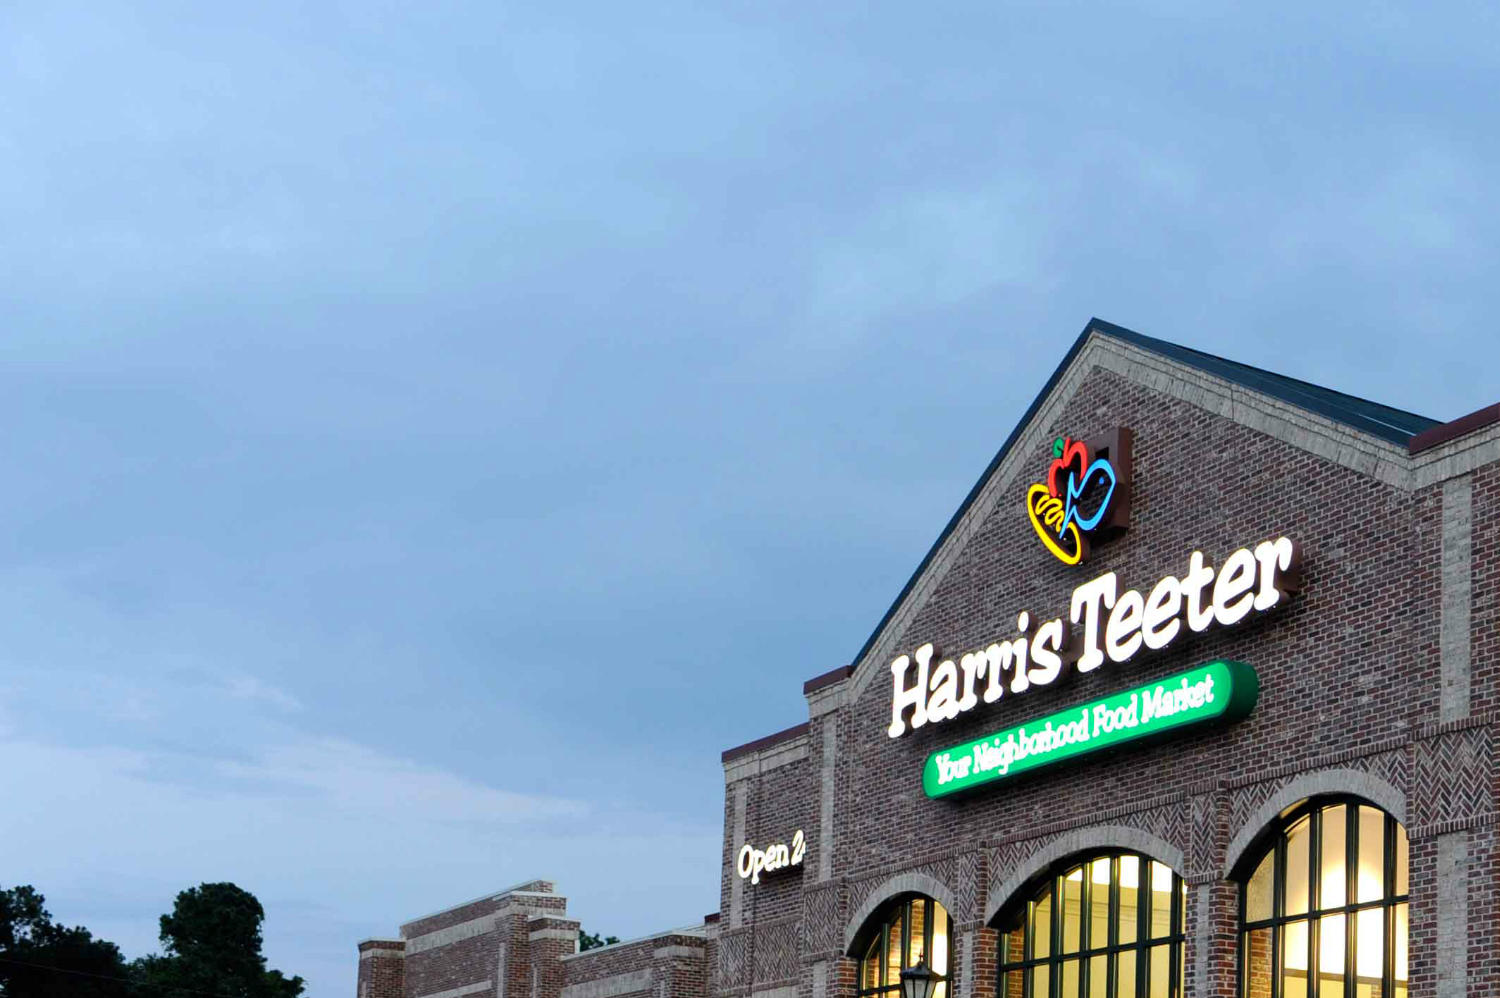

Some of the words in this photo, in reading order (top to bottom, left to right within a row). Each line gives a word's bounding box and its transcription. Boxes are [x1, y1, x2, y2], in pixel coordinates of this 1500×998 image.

[887, 610, 1064, 738] Harris
[1069, 536, 1294, 673] Teeter
[935, 751, 973, 785] Your
[973, 708, 1089, 775] Neighborhood
[1091, 693, 1139, 737] Food
[1140, 674, 1215, 723] Market
[737, 844, 790, 885] Open
